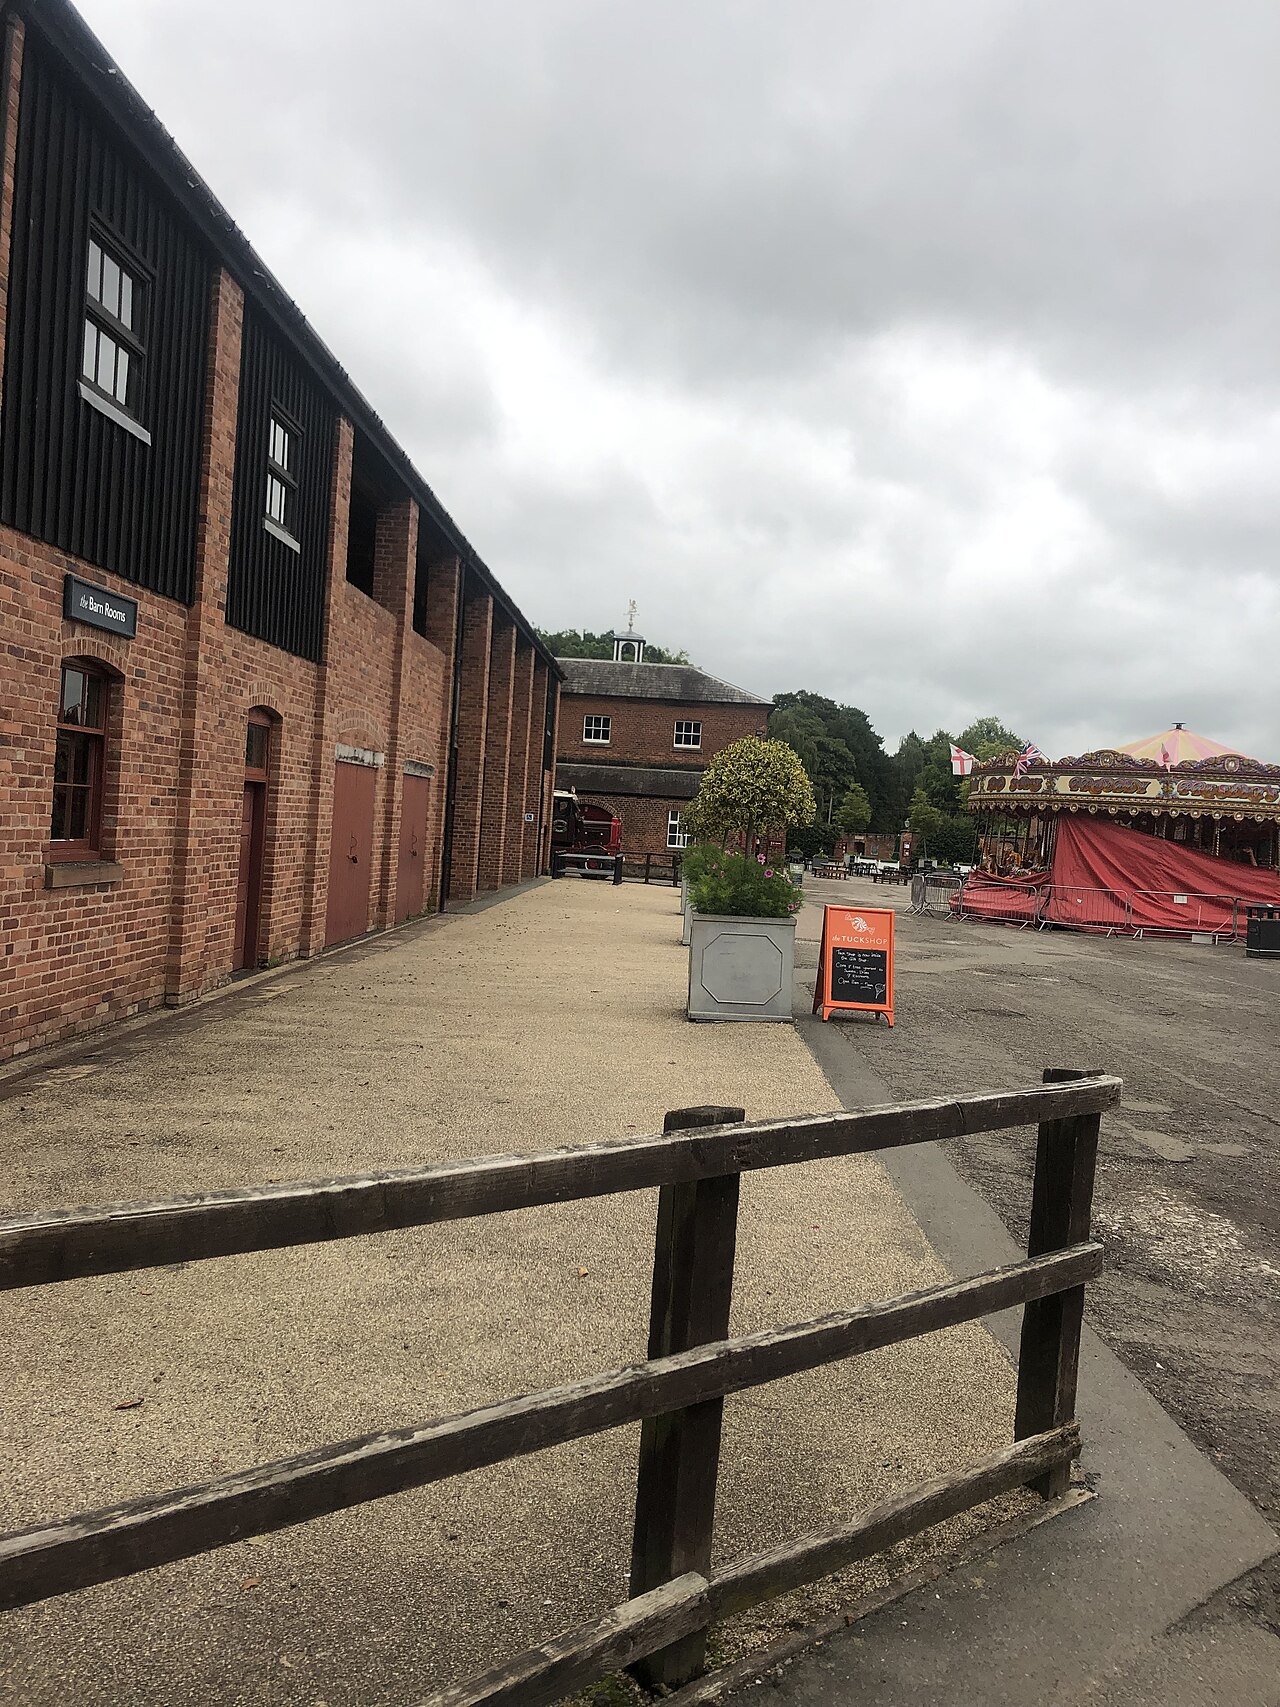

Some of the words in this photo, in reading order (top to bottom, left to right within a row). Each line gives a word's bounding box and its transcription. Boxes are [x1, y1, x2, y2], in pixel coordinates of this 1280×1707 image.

[80, 594, 88, 609] the
[89, 596, 104, 615] Barn
[104, 602, 126, 622] Rooms
[832, 934, 841, 942] the
